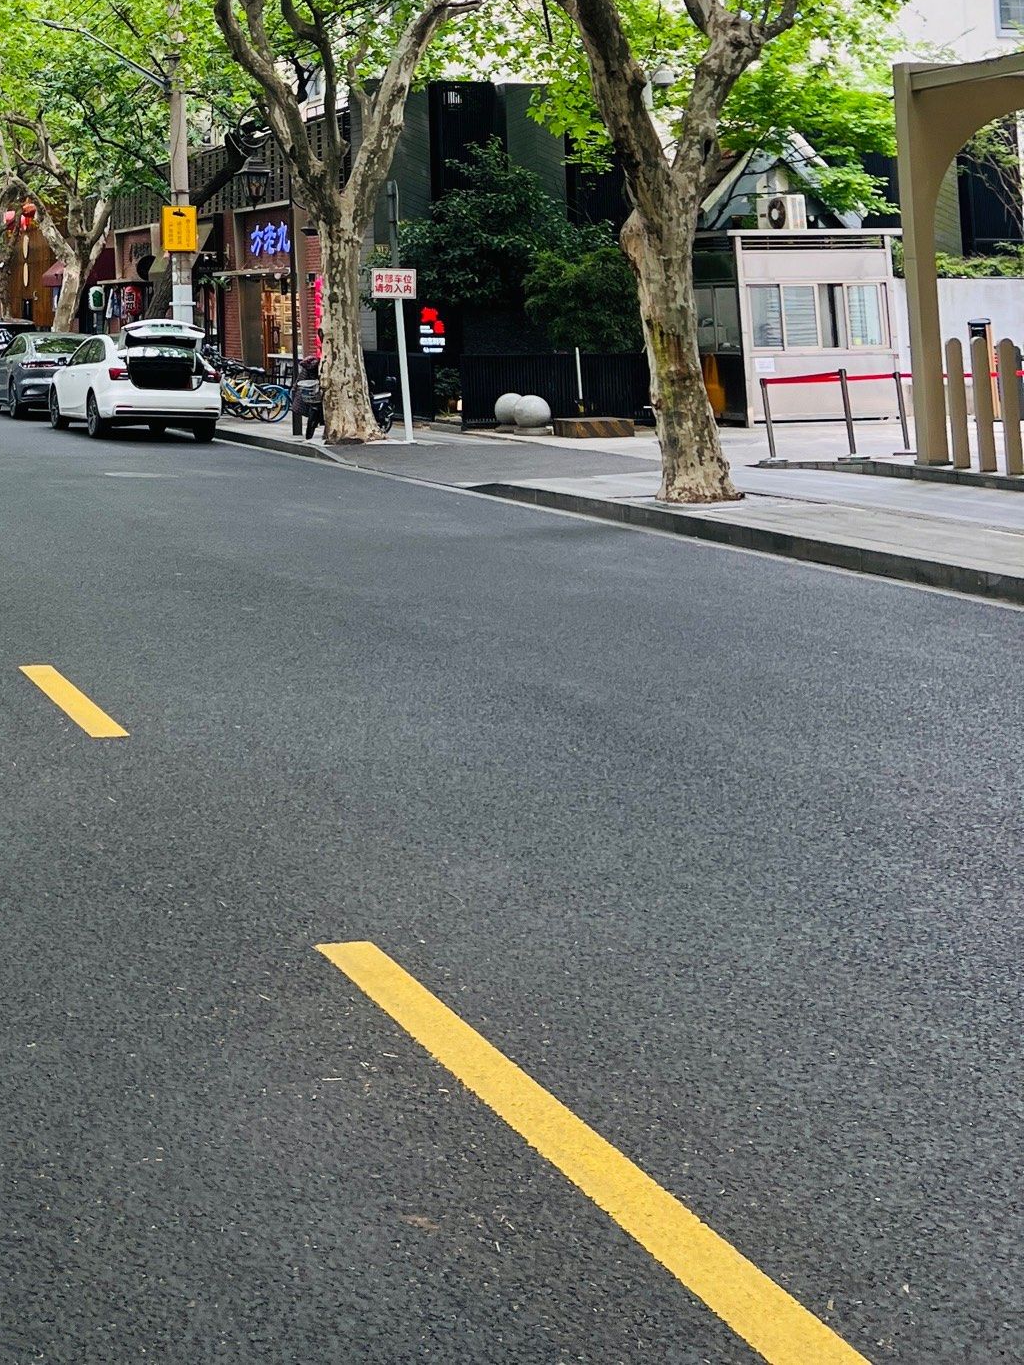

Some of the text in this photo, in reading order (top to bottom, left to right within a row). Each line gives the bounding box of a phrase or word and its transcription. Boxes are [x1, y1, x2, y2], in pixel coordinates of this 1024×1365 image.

[375, 274, 412, 284] 内部车位
[375, 284, 412, 294] 请勿入内
